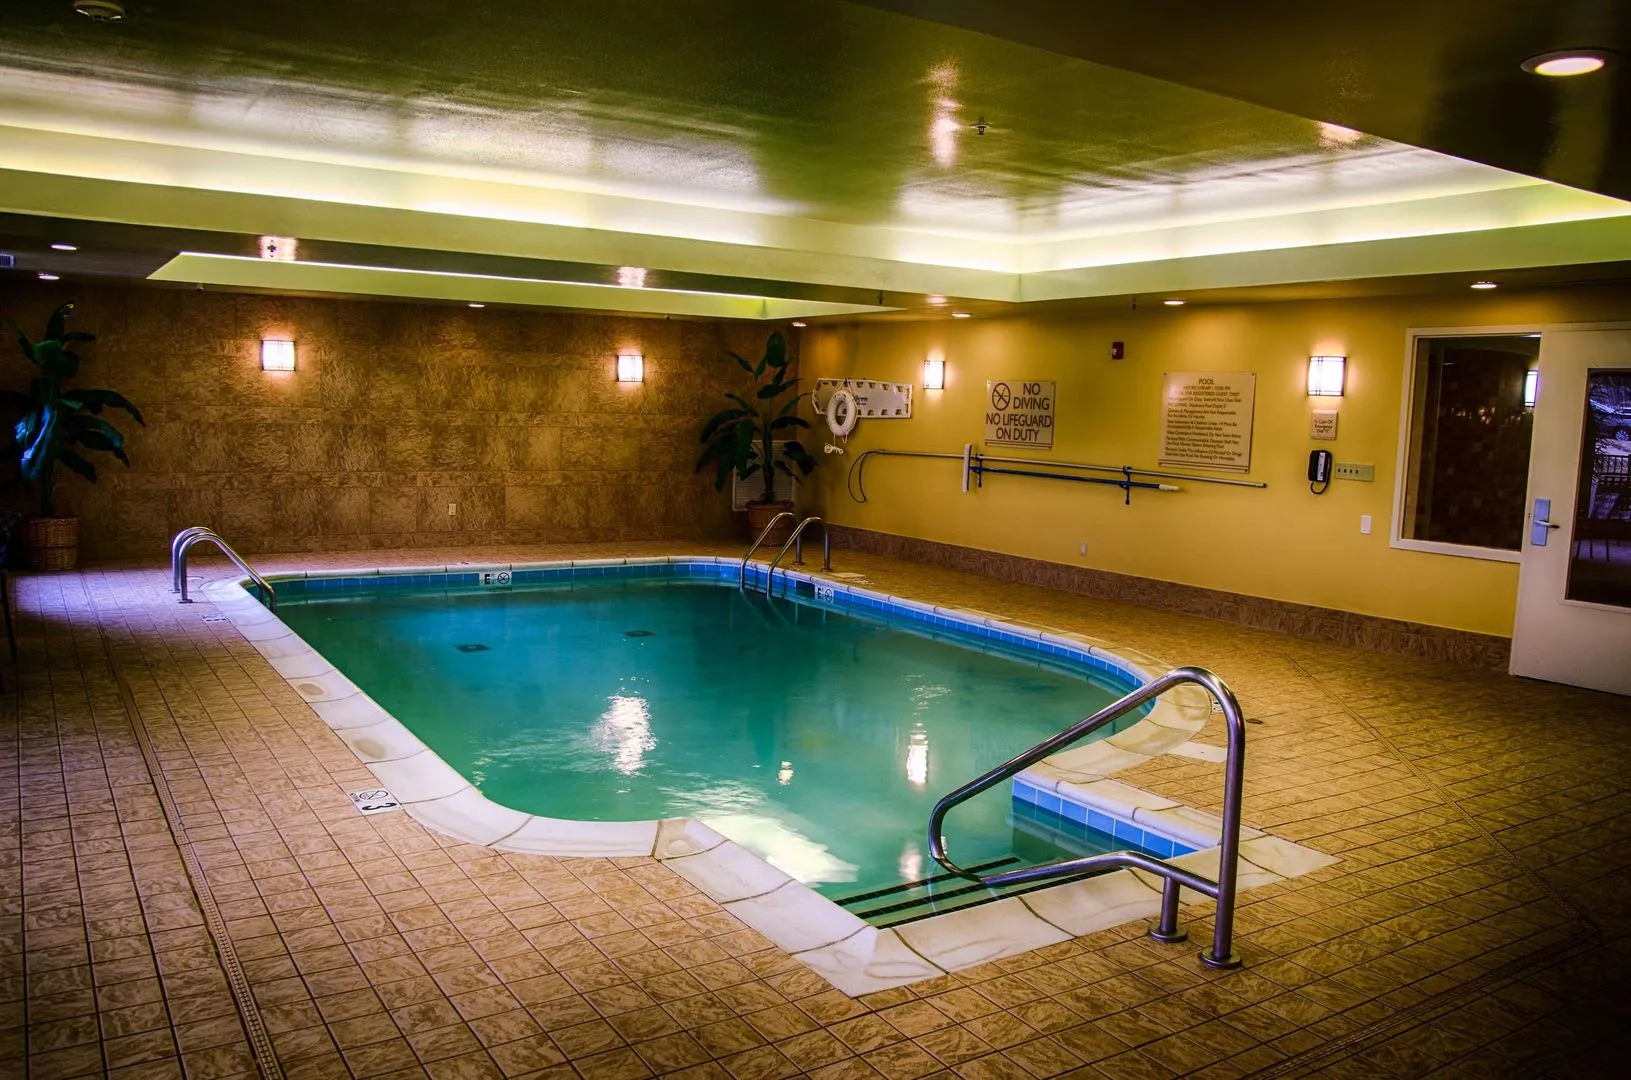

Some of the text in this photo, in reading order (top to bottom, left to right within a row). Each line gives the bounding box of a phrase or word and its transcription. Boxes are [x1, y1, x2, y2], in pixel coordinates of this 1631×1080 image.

[1023, 383, 1040, 395] NO
[1013, 397, 1049, 410] DIVING
[986, 413, 1052, 428] NO LIFEGUARD
[996, 427, 1040, 442] ON DUTY
